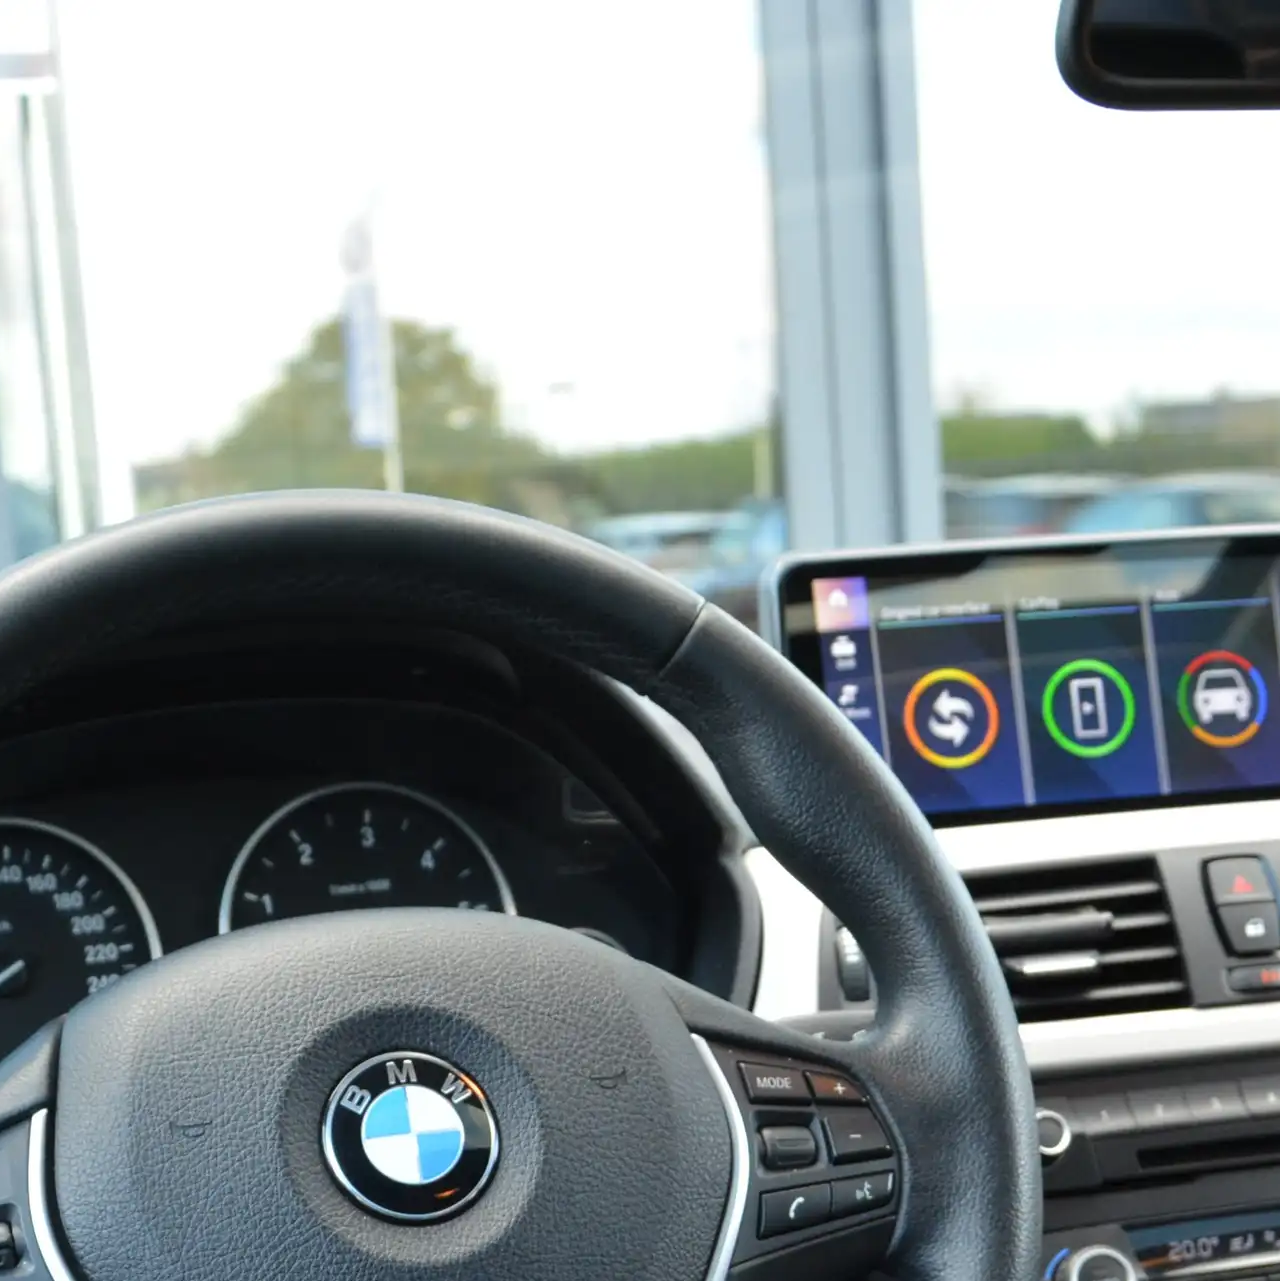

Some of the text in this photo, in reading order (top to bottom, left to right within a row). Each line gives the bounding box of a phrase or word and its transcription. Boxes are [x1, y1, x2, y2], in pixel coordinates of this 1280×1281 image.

[360, 825, 375, 848] 3
[298, 842, 314, 866] 2
[420, 849, 435, 871] 4
[25, 872, 58, 894] 160
[52, 890, 84, 911] 180
[261, 893, 274, 915] 1
[70, 913, 106, 935] 200
[84, 942, 119, 965] 220
[340, 1059, 472, 1115] BMW
[756, 1076, 793, 1089] MODE
